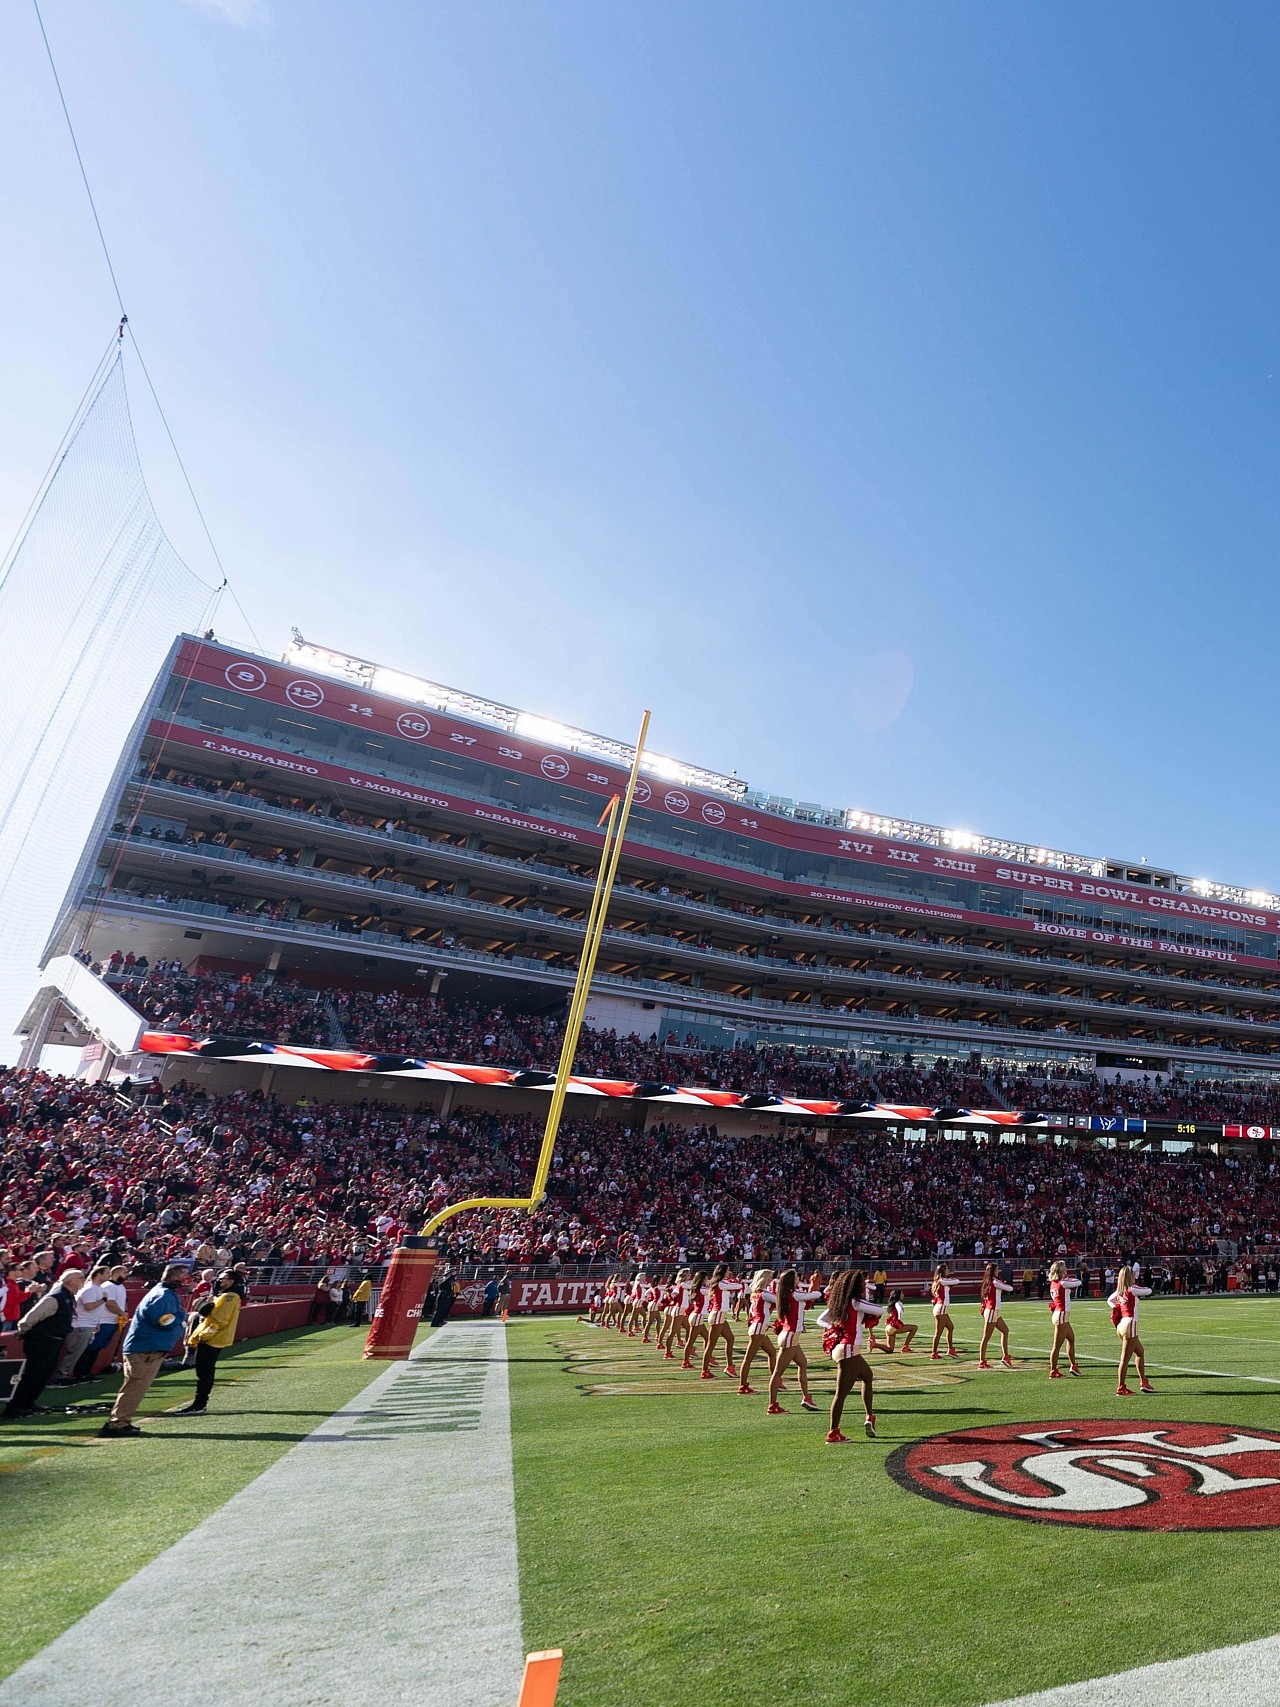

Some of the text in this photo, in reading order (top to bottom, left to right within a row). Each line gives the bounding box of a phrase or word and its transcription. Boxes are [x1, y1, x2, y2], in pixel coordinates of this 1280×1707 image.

[237, 671, 256, 683] 8
[290, 686, 319, 701] 12
[347, 703, 374, 718] 14
[400, 718, 426, 734] 16
[450, 733, 478, 746] 27
[203, 739, 319, 777] T. MORABITO
[498, 746, 524, 760] 33
[543, 759, 568, 774] 34
[586, 772, 609, 786] 35
[349, 776, 450, 808] V. MORABITO
[665, 795, 688, 808] 39
[704, 808, 724, 819] 42
[739, 818, 759, 829] 44
[560, 831, 579, 841] JR.
[838, 839, 874, 855] XVI
[887, 848, 920, 864] XIX
[933, 856, 976, 874] XXIII
[996, 868, 1074, 892] SUPER
[1080, 883, 1143, 905] BOWL
[1148, 896, 1267, 926] CHAMPIONS
[855, 898, 902, 910] DIVISION
[905, 906, 963, 920] CHAMPIONS
[1033, 922, 1236, 962] HOME OF THE FAITHFUL
[1177, 1124, 1196, 1134] 5:16
